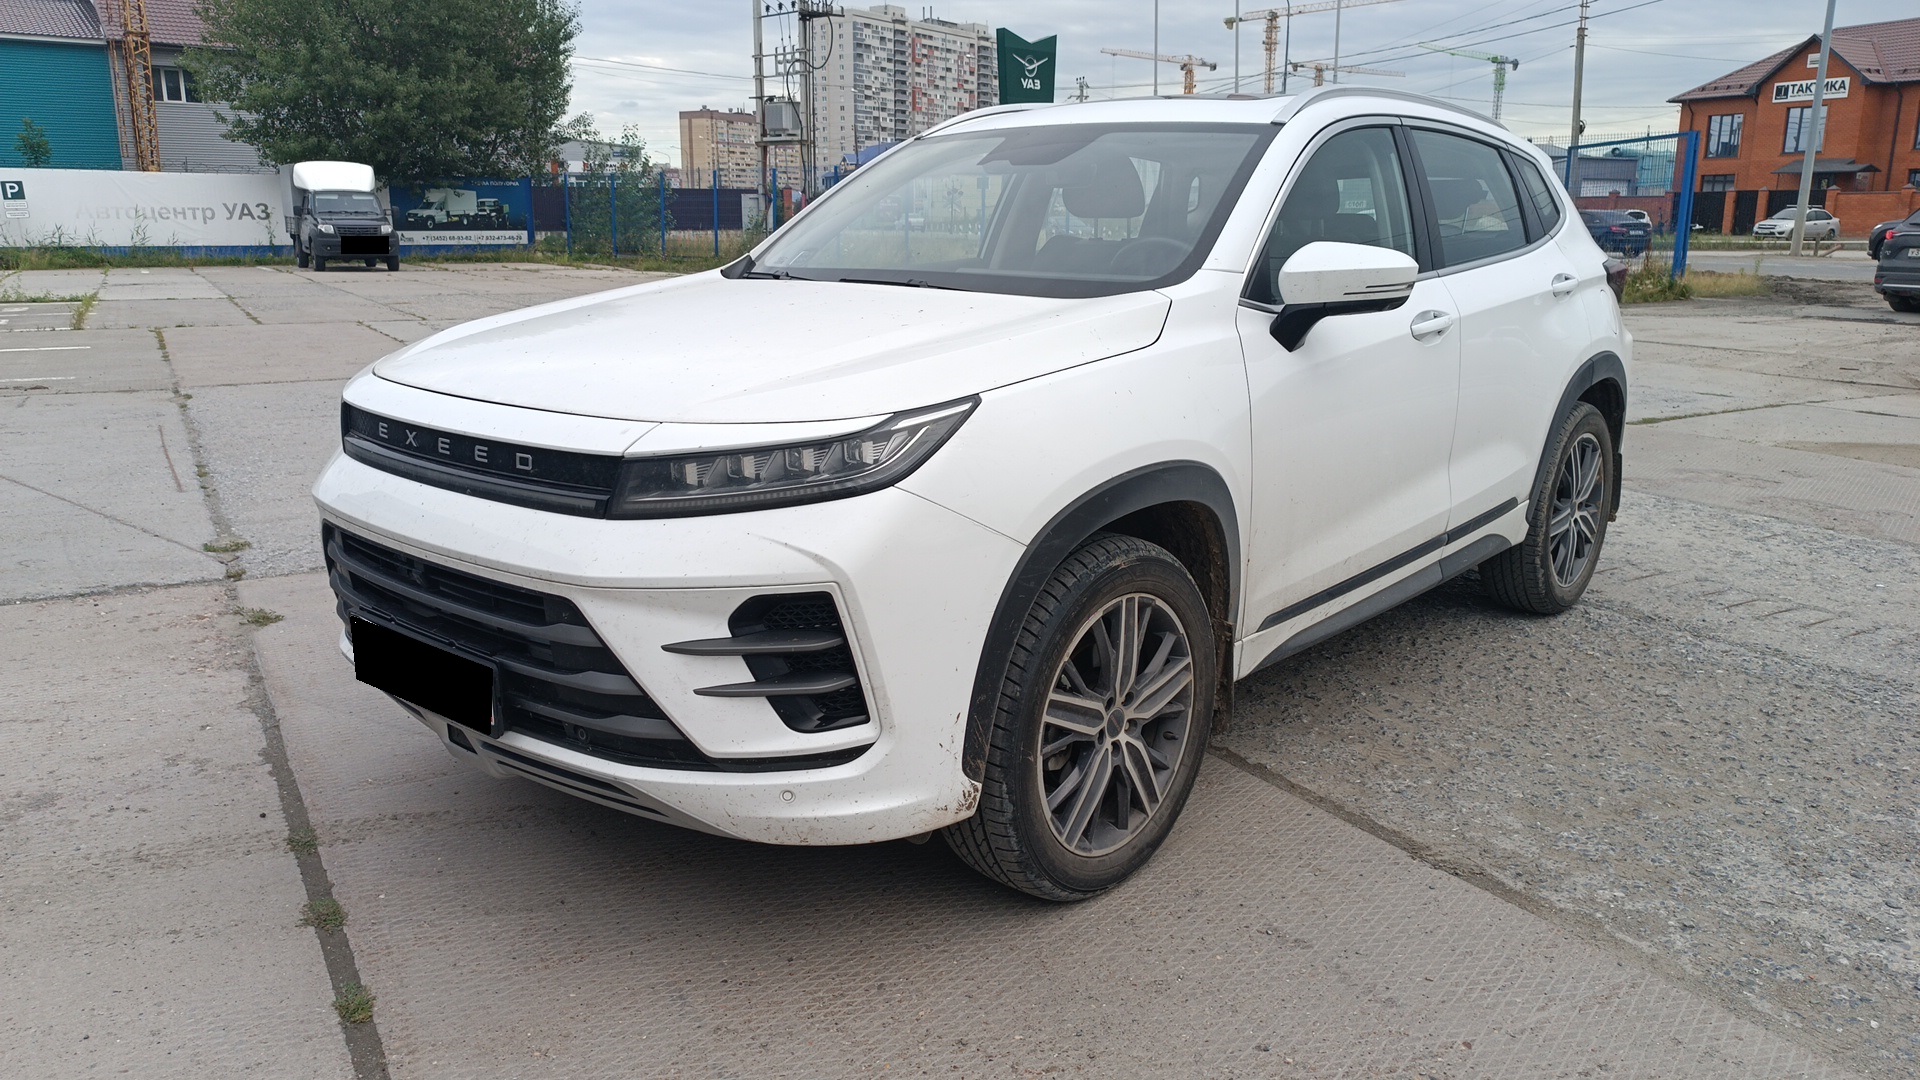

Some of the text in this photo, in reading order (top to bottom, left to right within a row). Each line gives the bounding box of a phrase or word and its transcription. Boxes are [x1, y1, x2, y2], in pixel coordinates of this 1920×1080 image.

[1020, 77, 1041, 90] УАЗ
[1790, 80, 1846, 94] ТАКИКА
[5, 183, 19, 198] P
[75, 202, 270, 225] Автоцентр УАЗ
[378, 422, 532, 471] EXEED
